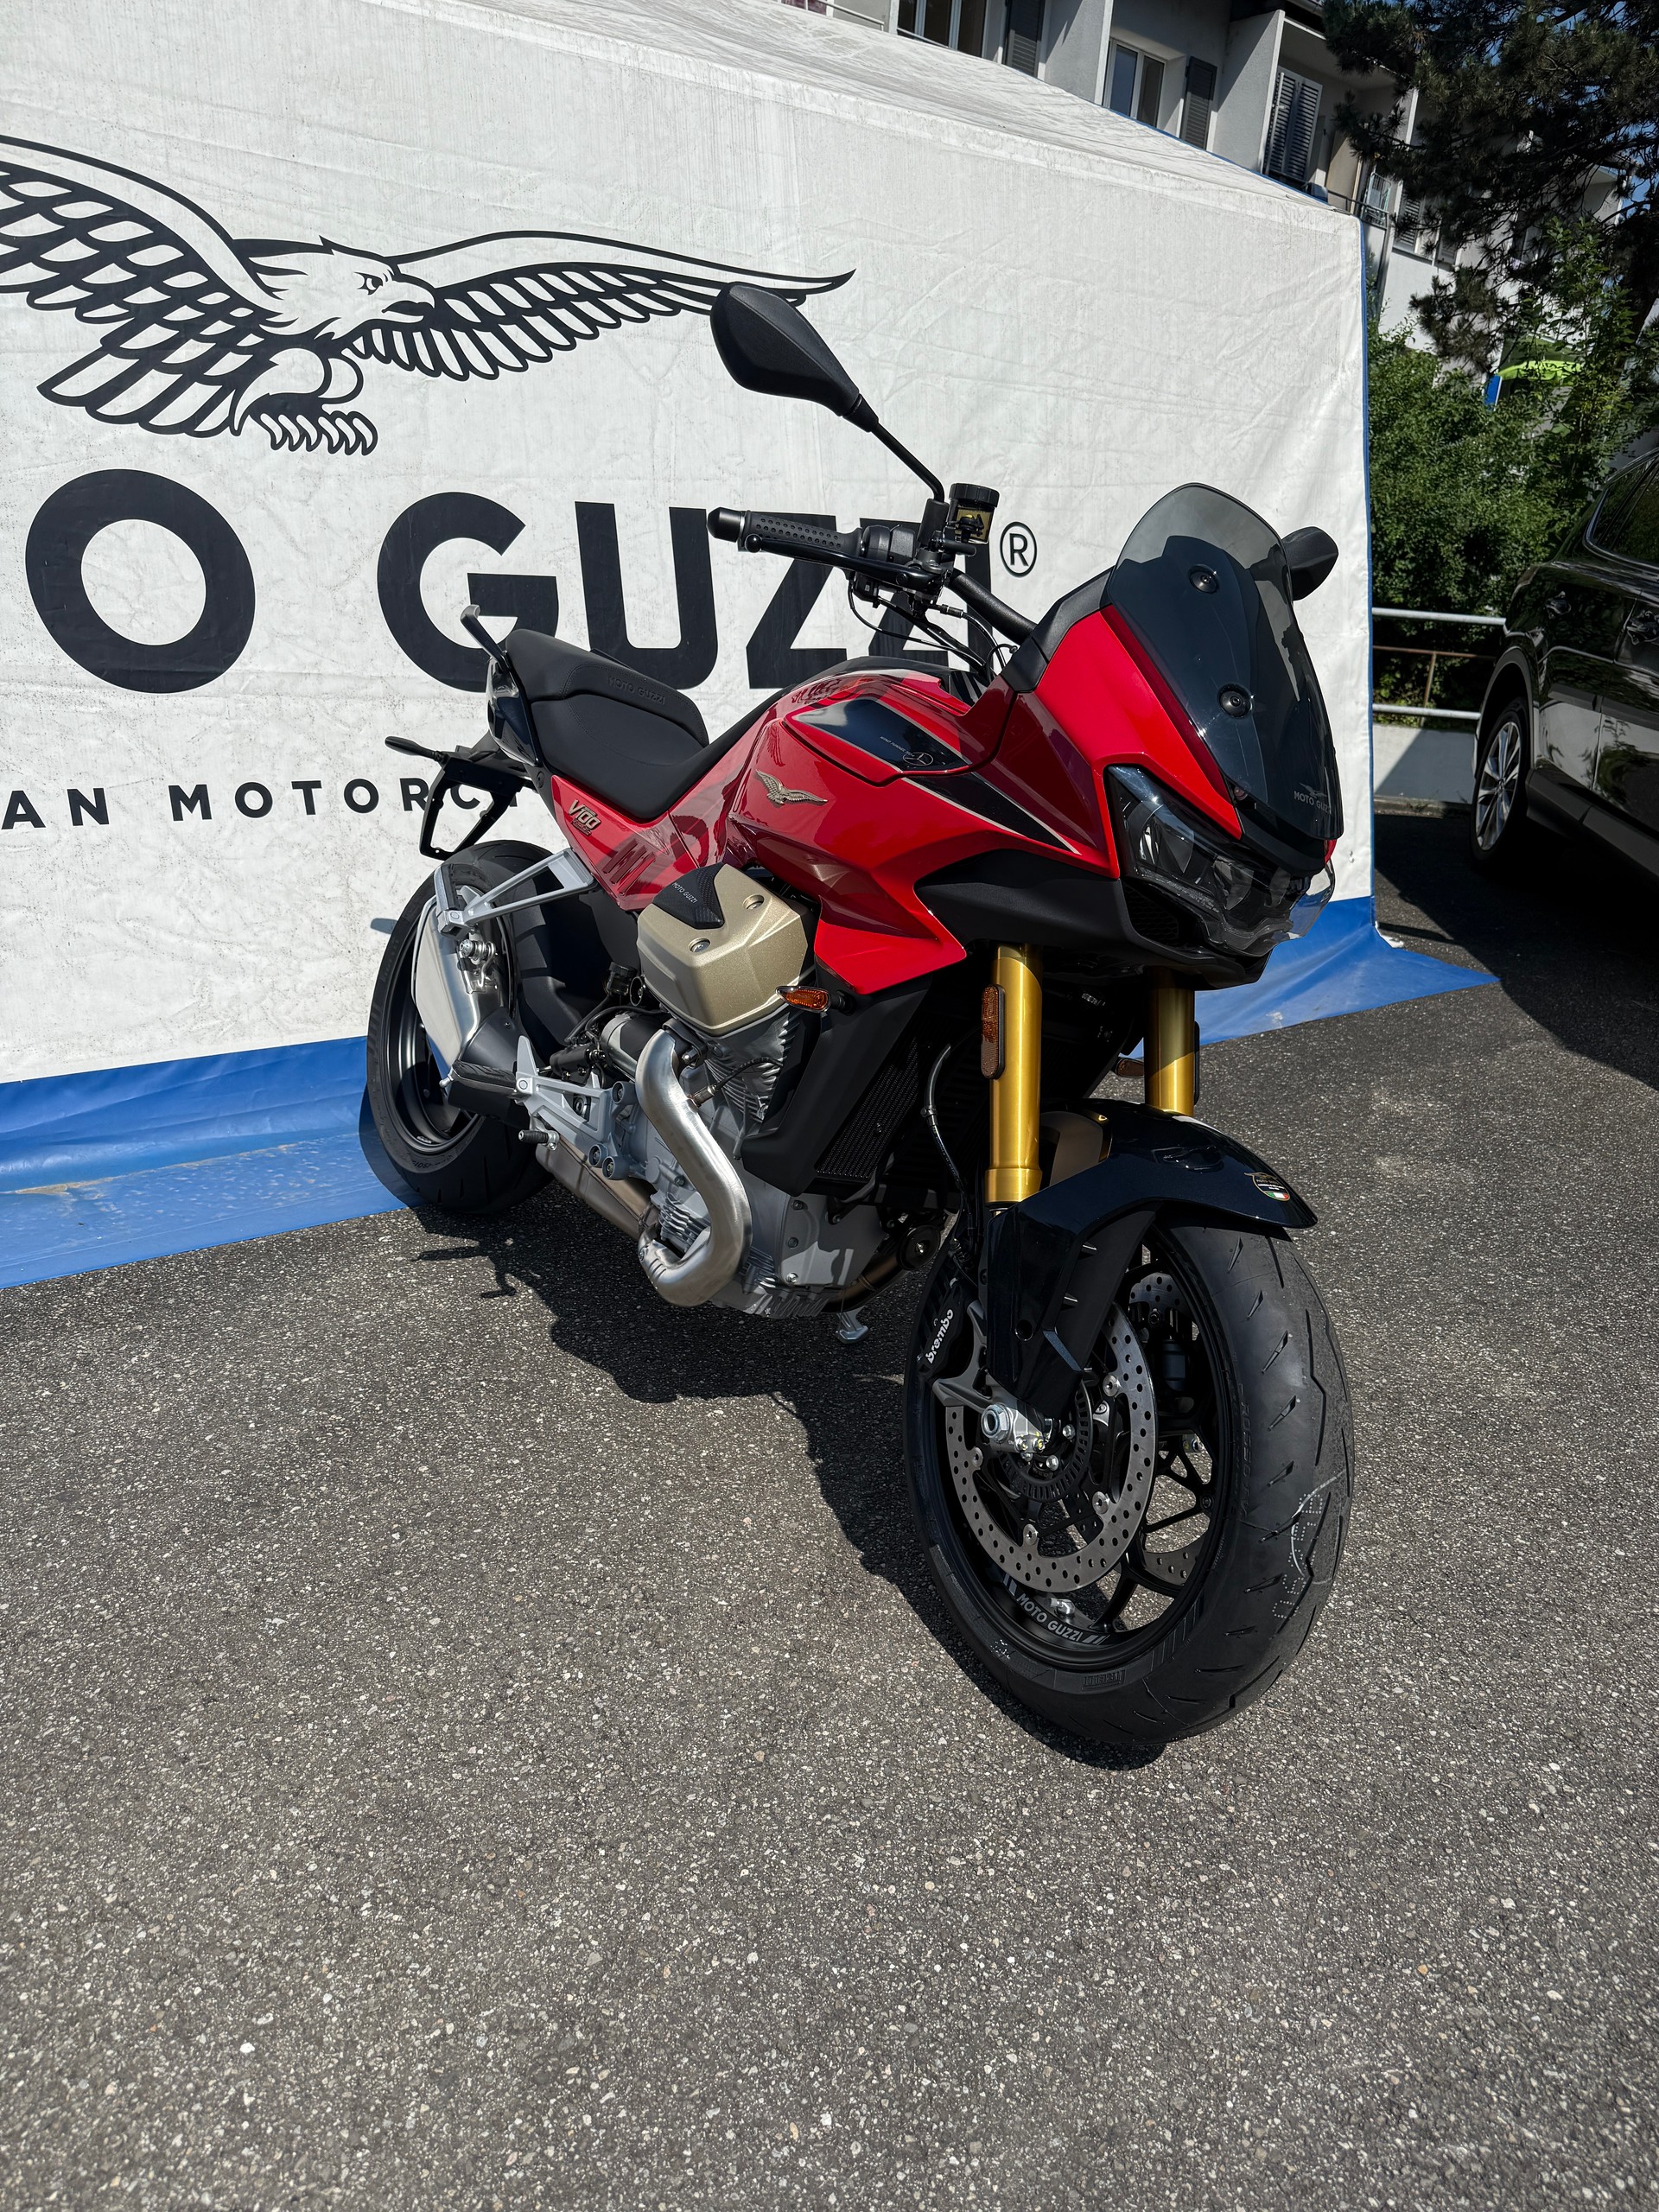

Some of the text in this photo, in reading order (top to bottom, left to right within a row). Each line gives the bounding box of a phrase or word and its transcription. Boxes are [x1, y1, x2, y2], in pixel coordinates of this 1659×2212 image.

[168, 777, 518, 822] MOTORC
[569, 799, 601, 830] V100
[1294, 791, 1314, 805] MOTO
[672, 881, 697, 904] MOTO GUZZI
[925, 1309, 953, 1363] brembo
[1017, 1593, 1084, 1642] MOTO GUZZI
